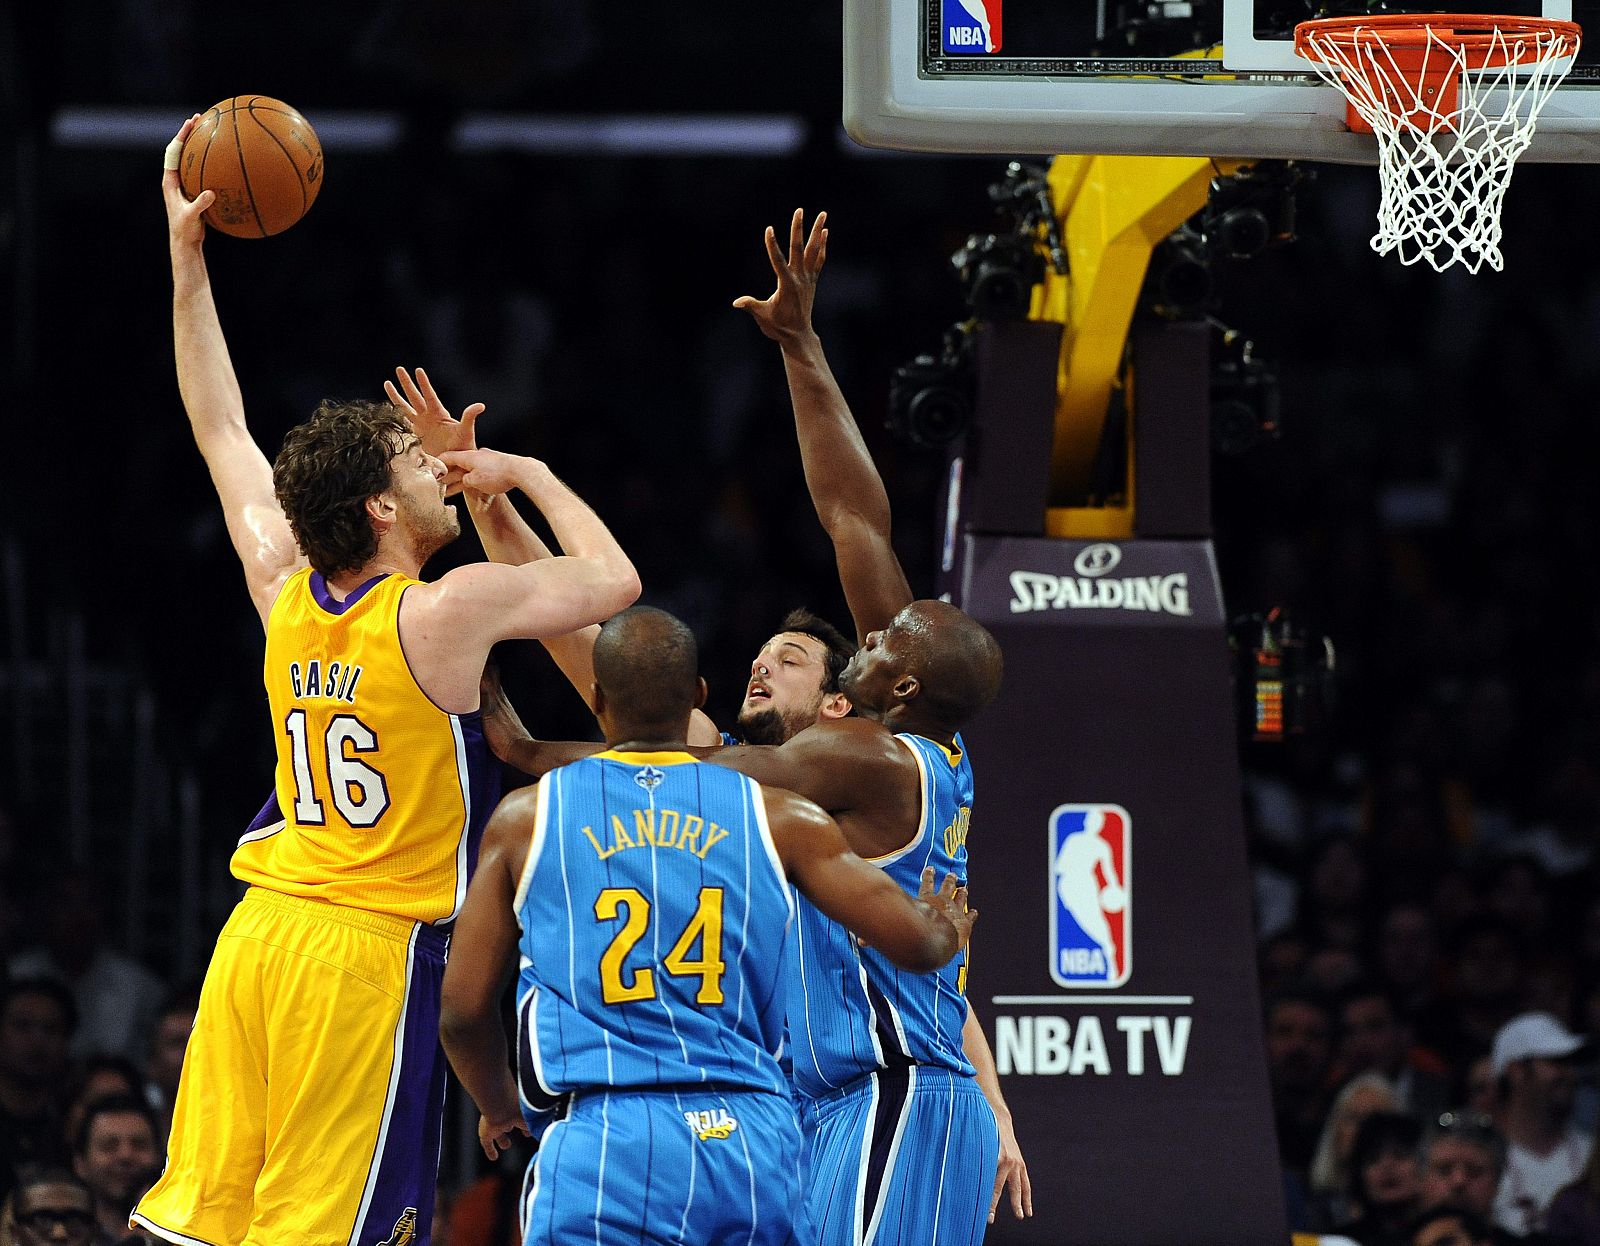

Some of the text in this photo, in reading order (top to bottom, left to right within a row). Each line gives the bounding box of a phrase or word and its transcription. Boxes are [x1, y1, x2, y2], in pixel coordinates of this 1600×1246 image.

[949, 27, 984, 45] NBA
[1009, 572, 1191, 616] SPALDING
[289, 660, 362, 704] GASOL
[285, 708, 391, 828] 16
[582, 810, 729, 861] LANDRY
[594, 887, 725, 1005] 24
[1060, 948, 1104, 973] NBA
[995, 1014, 1193, 1075] NBA TV
